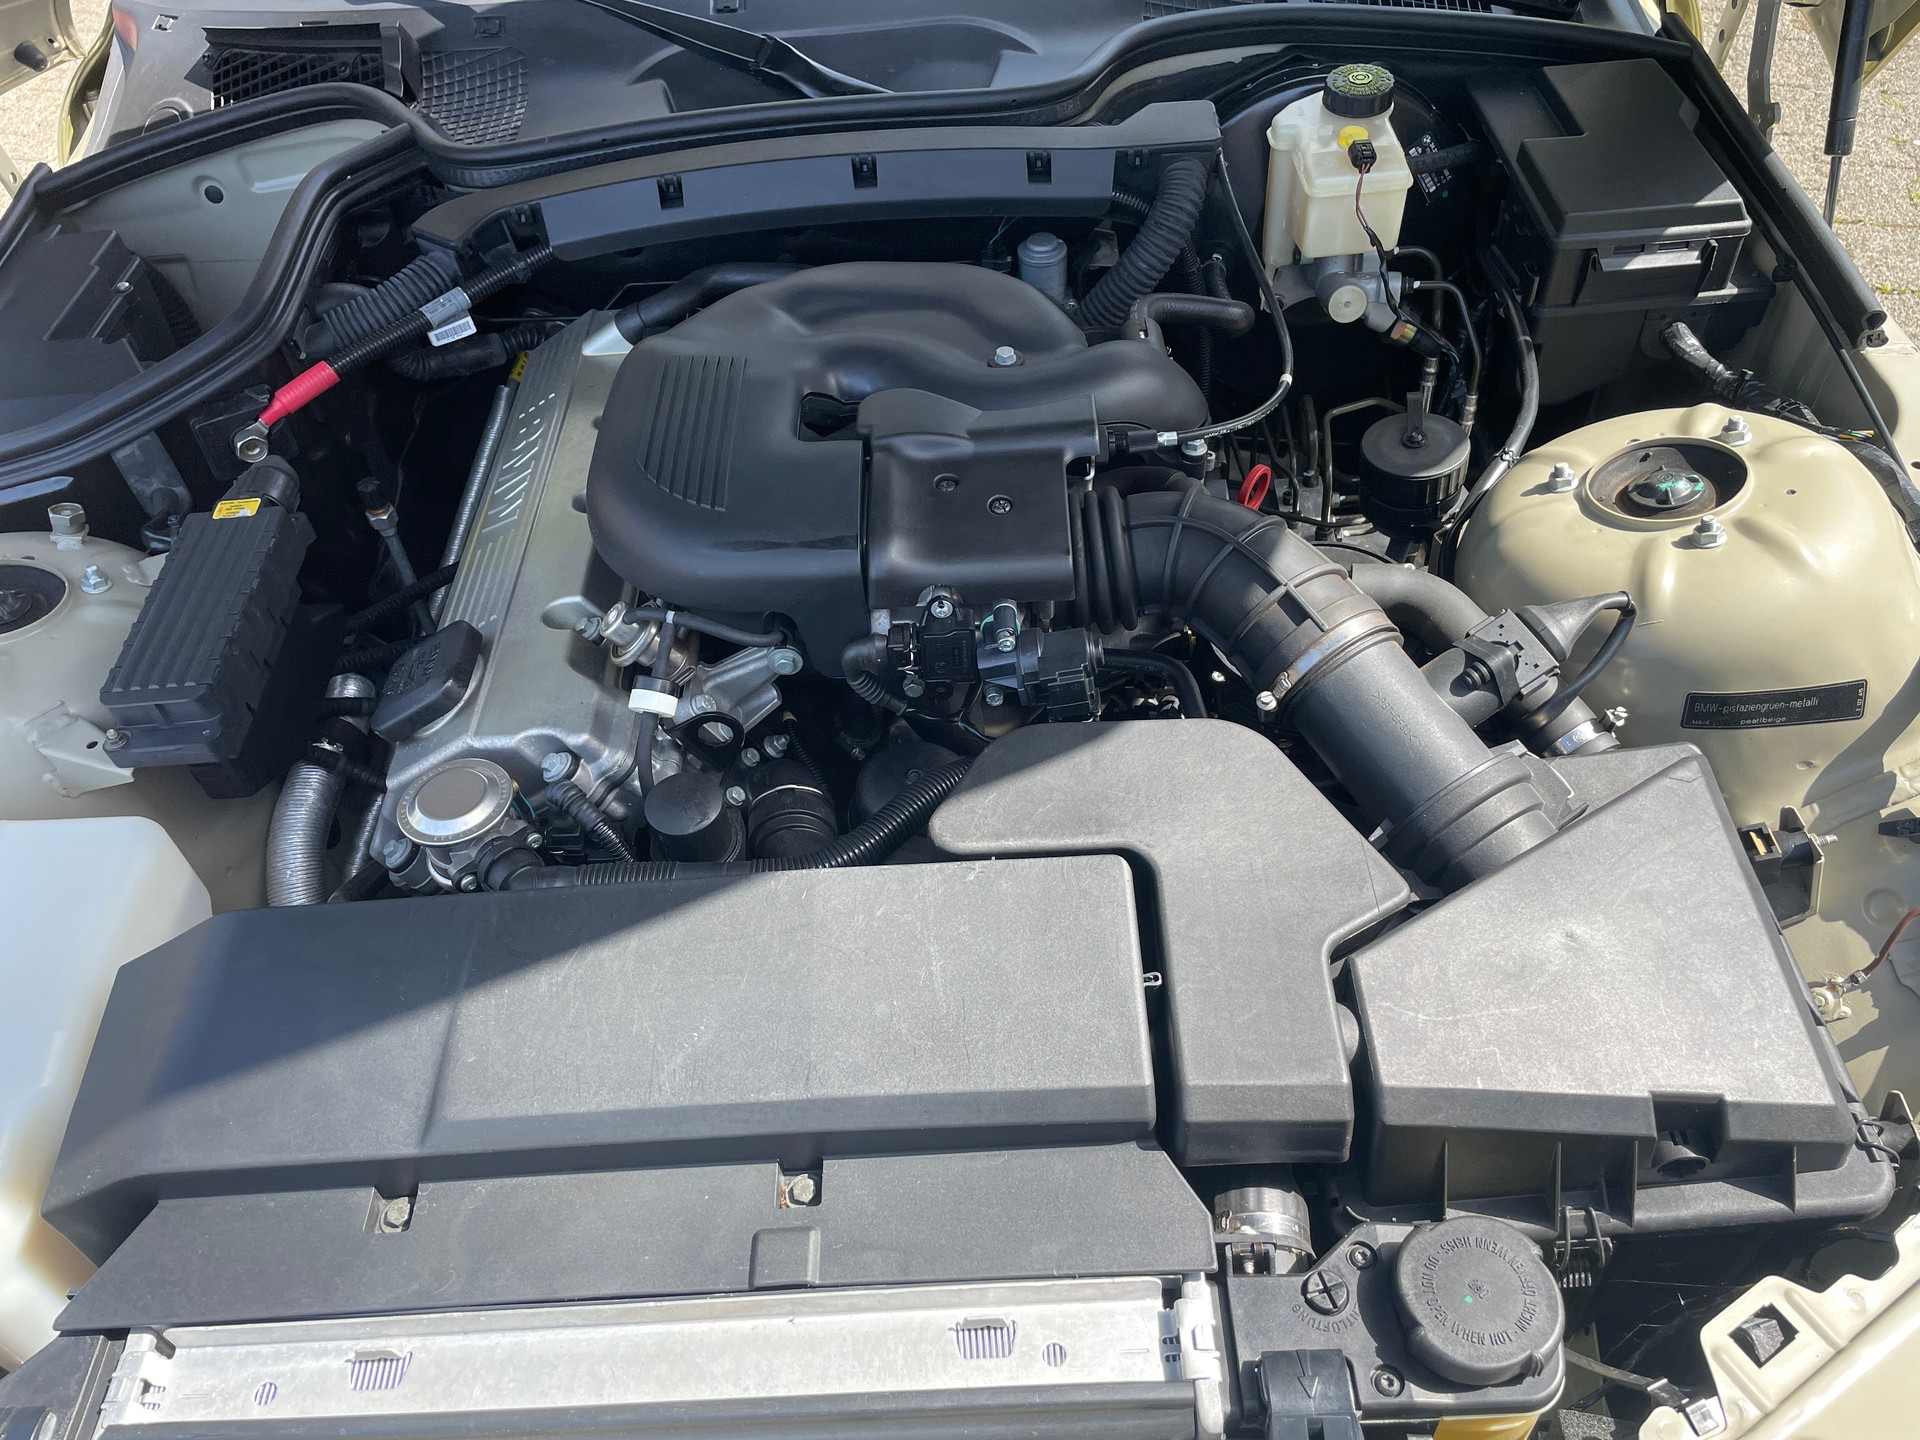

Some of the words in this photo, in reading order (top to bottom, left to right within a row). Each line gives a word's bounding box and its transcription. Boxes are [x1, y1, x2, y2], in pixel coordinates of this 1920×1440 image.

[1440, 1236, 1472, 1254] HEISS
[1475, 1237, 1508, 1260] WENN
[1424, 1254, 1441, 1271] DO
[1421, 1272, 1437, 1295] NOT
[1426, 1298, 1449, 1327] OPEN
[1515, 1299, 1538, 1332] NICHT
[1450, 1320, 1486, 1346] WHEN
[1488, 1330, 1513, 1346] HOT
